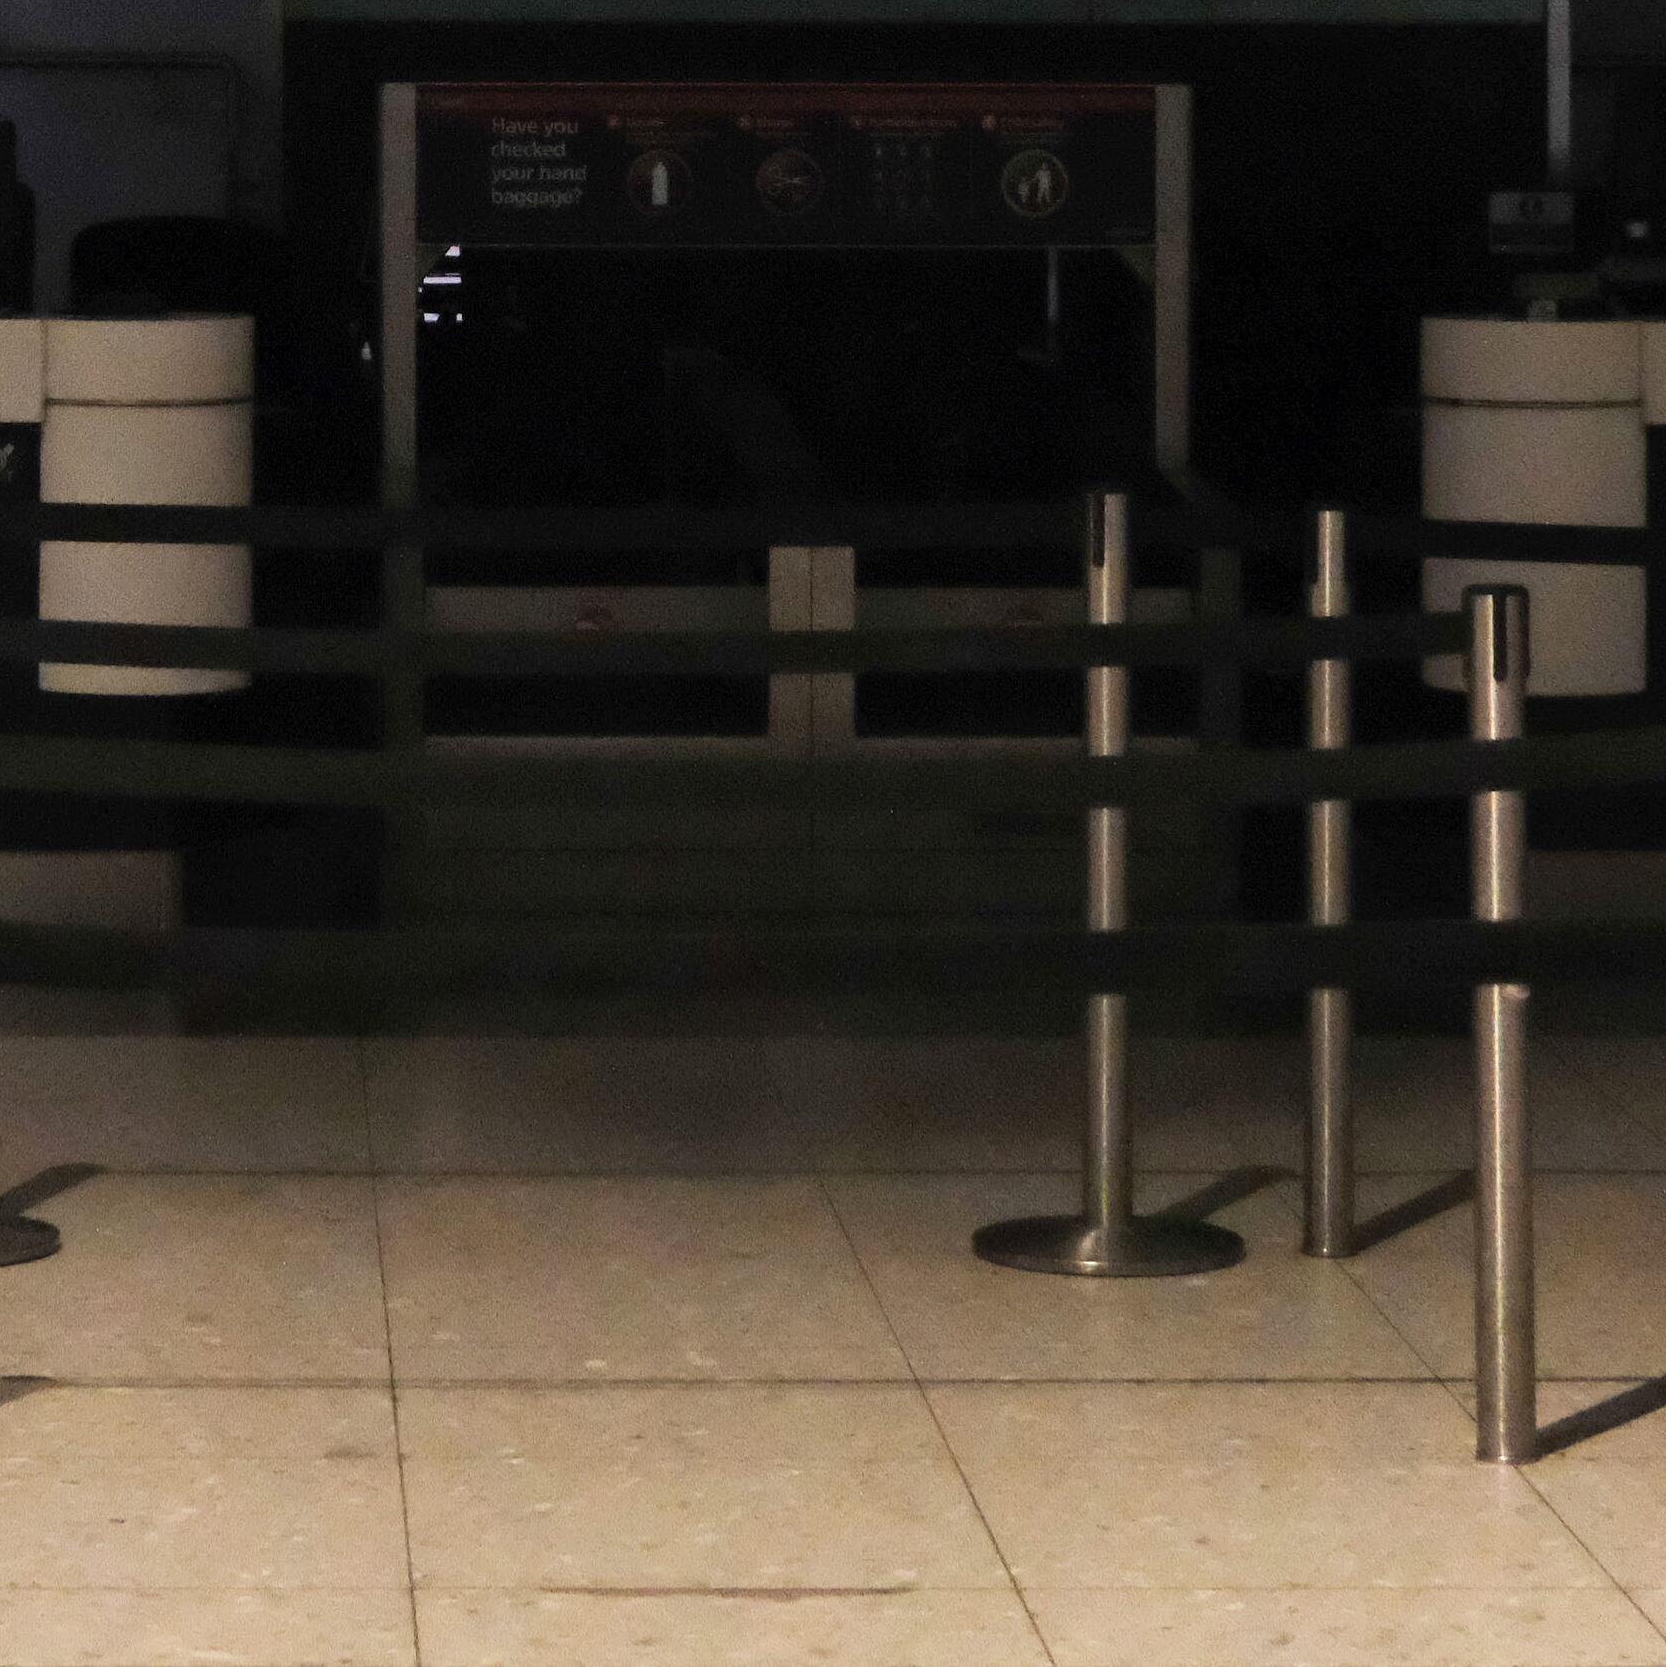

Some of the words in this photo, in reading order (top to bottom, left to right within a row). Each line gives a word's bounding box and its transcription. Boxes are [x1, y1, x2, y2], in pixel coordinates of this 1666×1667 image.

[491, 117, 538, 134] Have
[543, 120, 579, 138] you
[491, 140, 566, 158] checked
[491, 166, 535, 185] your
[539, 163, 587, 181] hand
